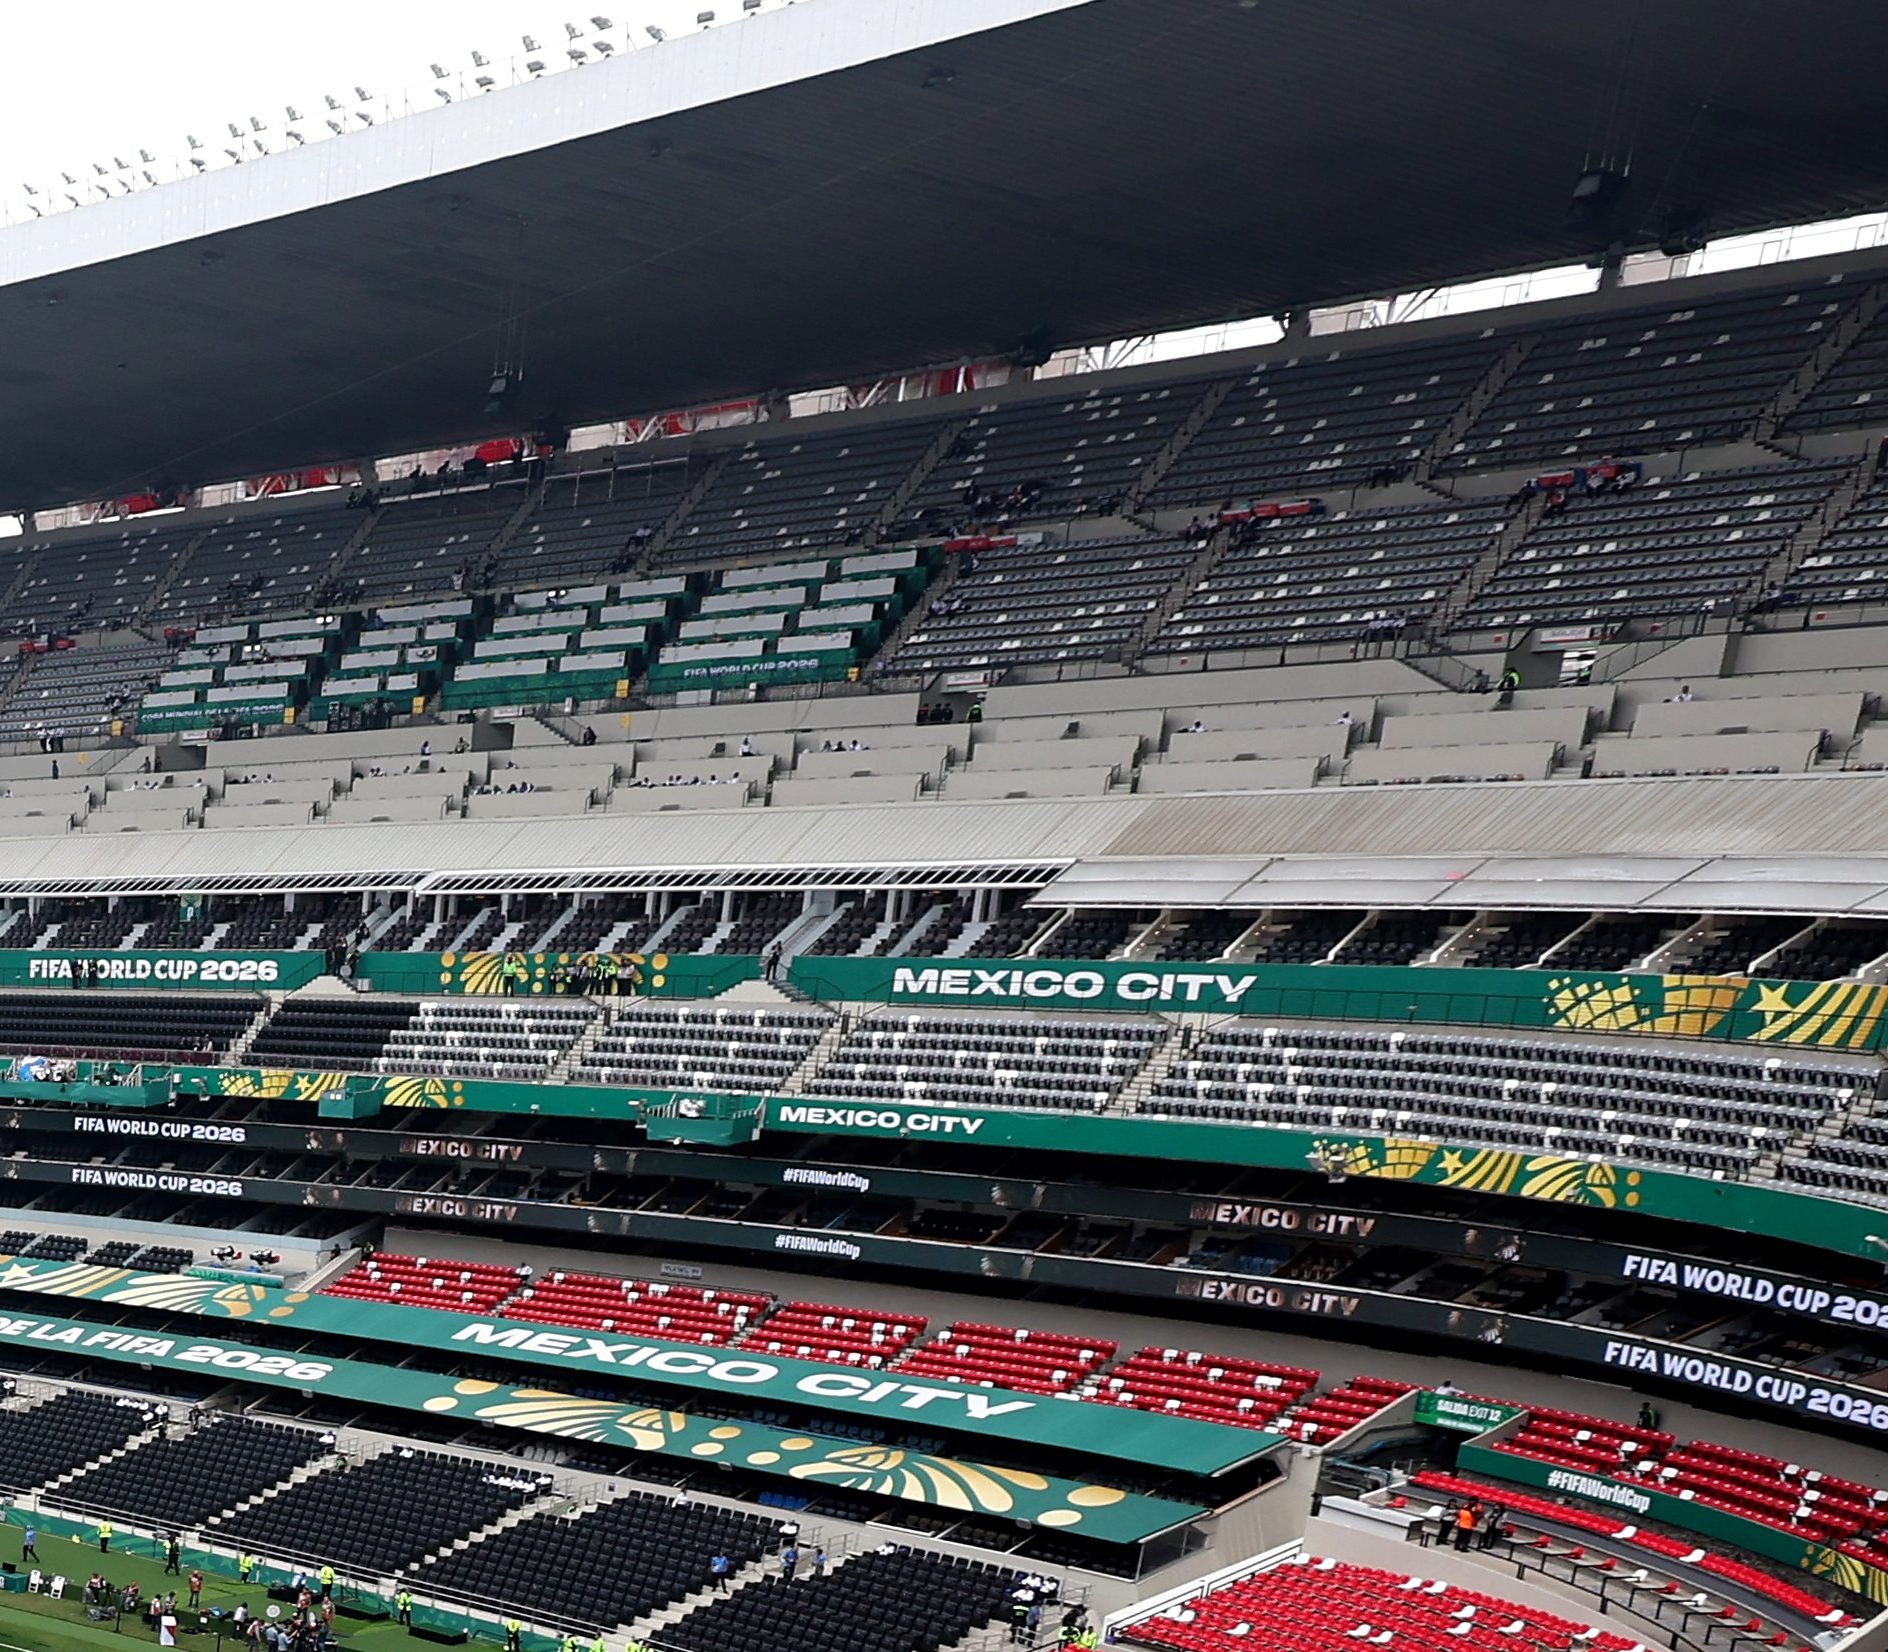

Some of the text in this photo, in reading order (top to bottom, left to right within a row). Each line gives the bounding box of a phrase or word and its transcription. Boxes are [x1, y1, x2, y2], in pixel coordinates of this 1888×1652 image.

[30, 958, 279, 982] FIFA WORLD CUP 2026
[893, 967, 1258, 1003] MEXICO CITY
[74, 1116, 246, 1142] FIFA WORLD CUP 2026
[778, 1105, 984, 1136] MEXICO CITY
[476, 1142, 523, 1162] CITY
[71, 1167, 243, 1197] FIFA WORLD CUP 2026
[783, 1167, 870, 1194] #FIFAWorldCup
[471, 1200, 518, 1221] CITY
[1189, 1200, 1377, 1238] MEXICO CITY
[775, 1233, 861, 1261] #FIFAWorldCup
[1175, 1277, 1362, 1317] MEXICO CITY
[1622, 1253, 1679, 1286] FIFA
[1681, 1261, 1775, 1303] WORLD
[1776, 1282, 1831, 1314] CUP
[27, 1323, 85, 1344] LA
[82, 1331, 175, 1357] FIFA
[174, 1345, 333, 1380] 2026
[451, 1323, 1036, 1419] MEXICO CITY
[1603, 1340, 1888, 1429] FIFA WORLD CUP 2026
[1488, 1408, 1503, 1422] 12
[1546, 1469, 1652, 1515] #FIFAWorldCup
